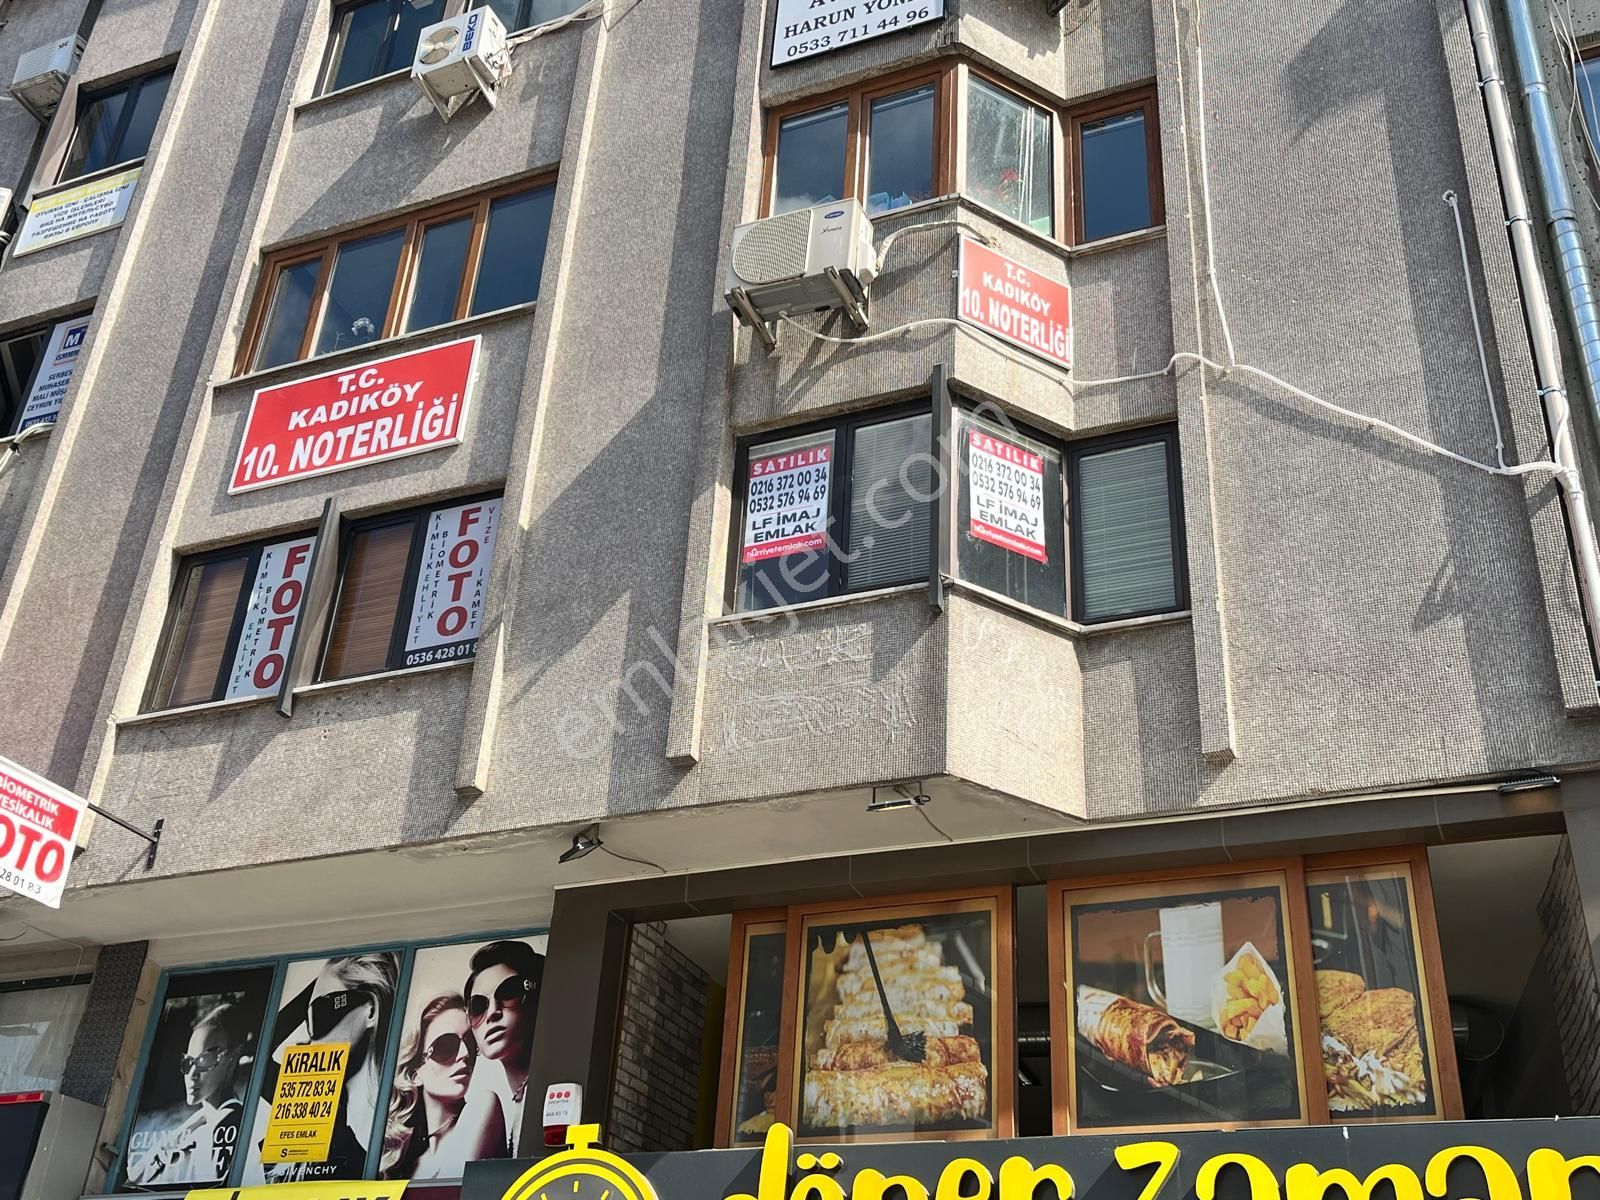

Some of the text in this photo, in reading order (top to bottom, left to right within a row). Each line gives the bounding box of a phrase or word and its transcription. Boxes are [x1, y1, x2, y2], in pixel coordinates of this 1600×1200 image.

[462, 14, 478, 52] BEKO
[783, 6, 856, 39] HARUN
[787, 6, 929, 57] 0533 711 44 96
[1004, 262, 1030, 288] T.C.
[962, 286, 984, 320] 10.
[982, 271, 1051, 316] KADIKÖY
[336, 368, 385, 394] T.C.
[287, 380, 424, 430] KADIKÖY
[242, 393, 459, 482] 10. NOTERLİĞİ
[972, 432, 1040, 471] SATILIK
[753, 448, 828, 476] SATILIK
[971, 452, 1041, 492] 0216 372 00 34
[750, 466, 827, 496] 0216 372 00 34
[972, 472, 1041, 511] 0532 576 94 69
[749, 484, 826, 514] 0532 576 94 69
[976, 495, 995, 509] LF
[752, 517, 773, 531] LF
[754, 522, 816, 544] EMLAK
[980, 510, 1037, 541] EMLAK
[436, 506, 482, 637] FOTO
[253, 544, 310, 689] FOTO
[406, 650, 433, 665] 0536
[434, 646, 455, 660] 428
[457, 644, 470, 656] 01
[13, 875, 25, 888] 01
[28, 882, 42, 894] 83
[280, 1080, 337, 1098] 535 772 83 34
[275, 1101, 333, 1120] 216 338 40 24
[280, 1130, 317, 1139] EFES EMLAK
